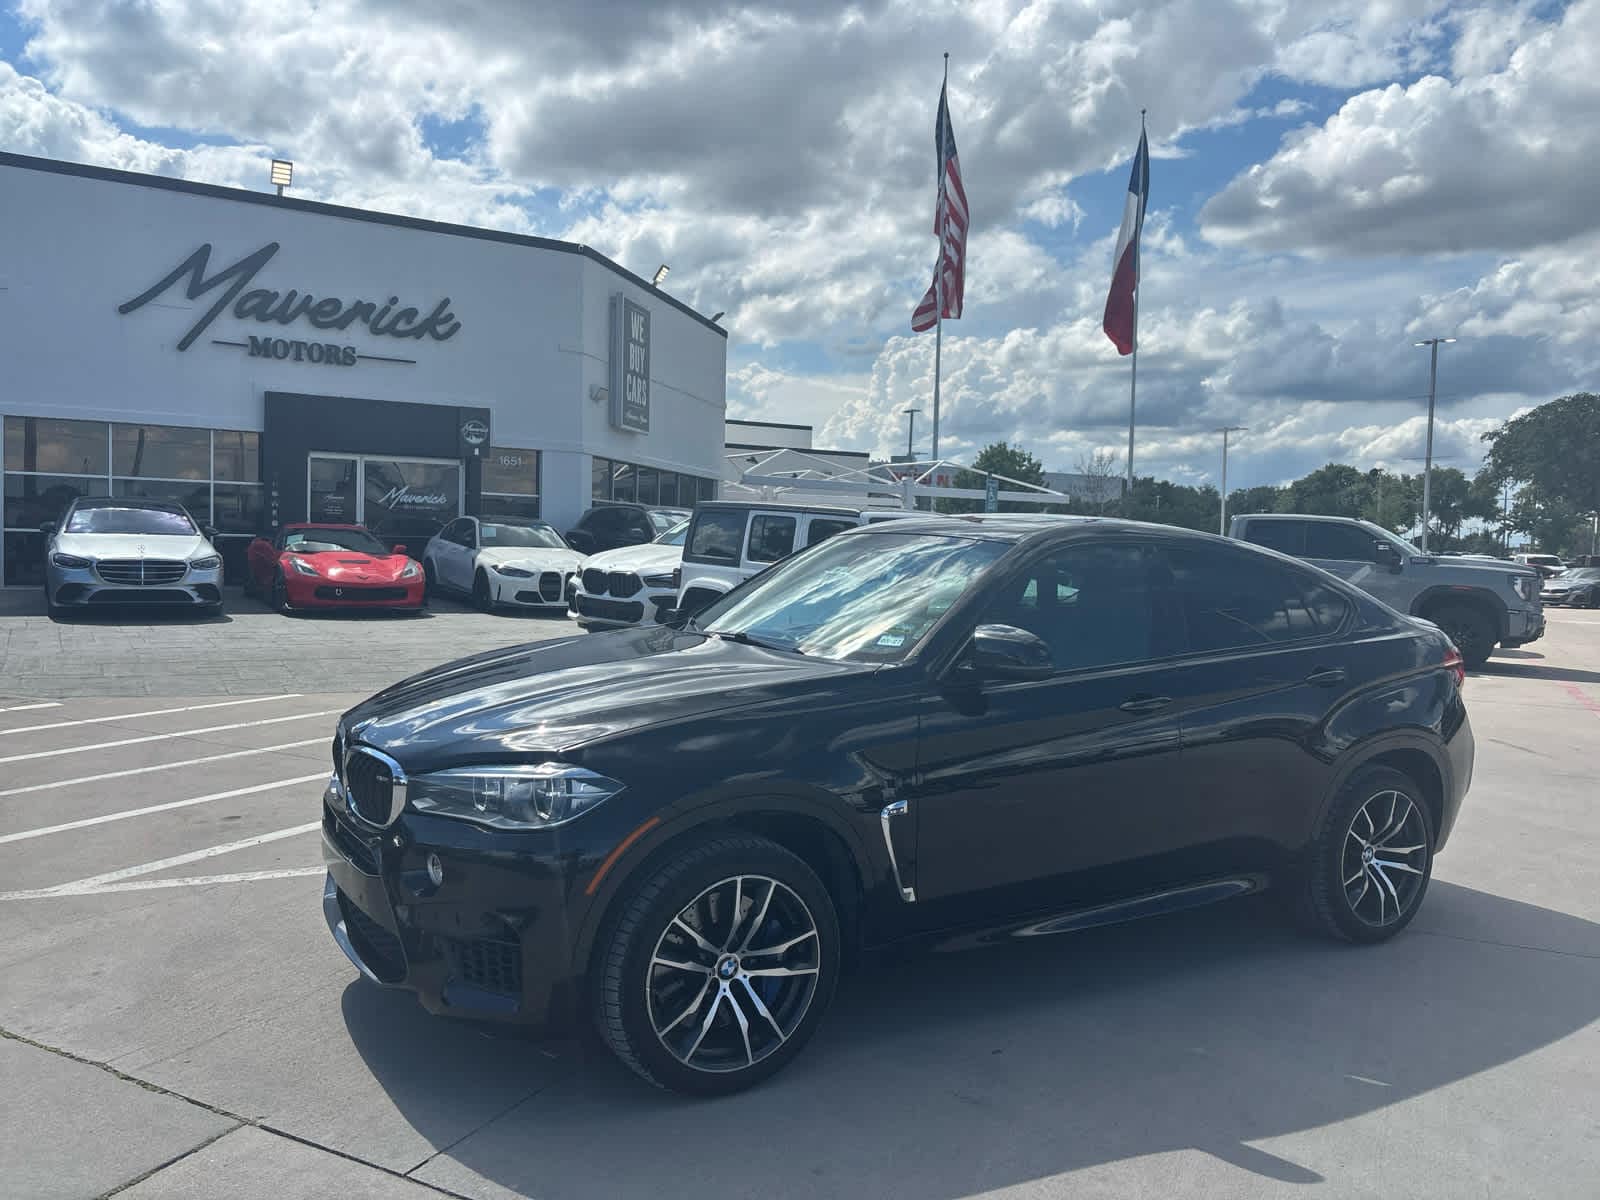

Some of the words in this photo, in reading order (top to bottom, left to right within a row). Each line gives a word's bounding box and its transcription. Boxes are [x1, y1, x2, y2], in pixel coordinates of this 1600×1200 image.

[118, 242, 462, 351] Maverick
[630, 312, 645, 342] WE
[248, 335, 358, 367] MOTORS
[628, 343, 646, 374] BUY
[626, 373, 647, 407] CARS
[499, 455, 522, 466] 1651
[378, 485, 448, 509] Maverick
